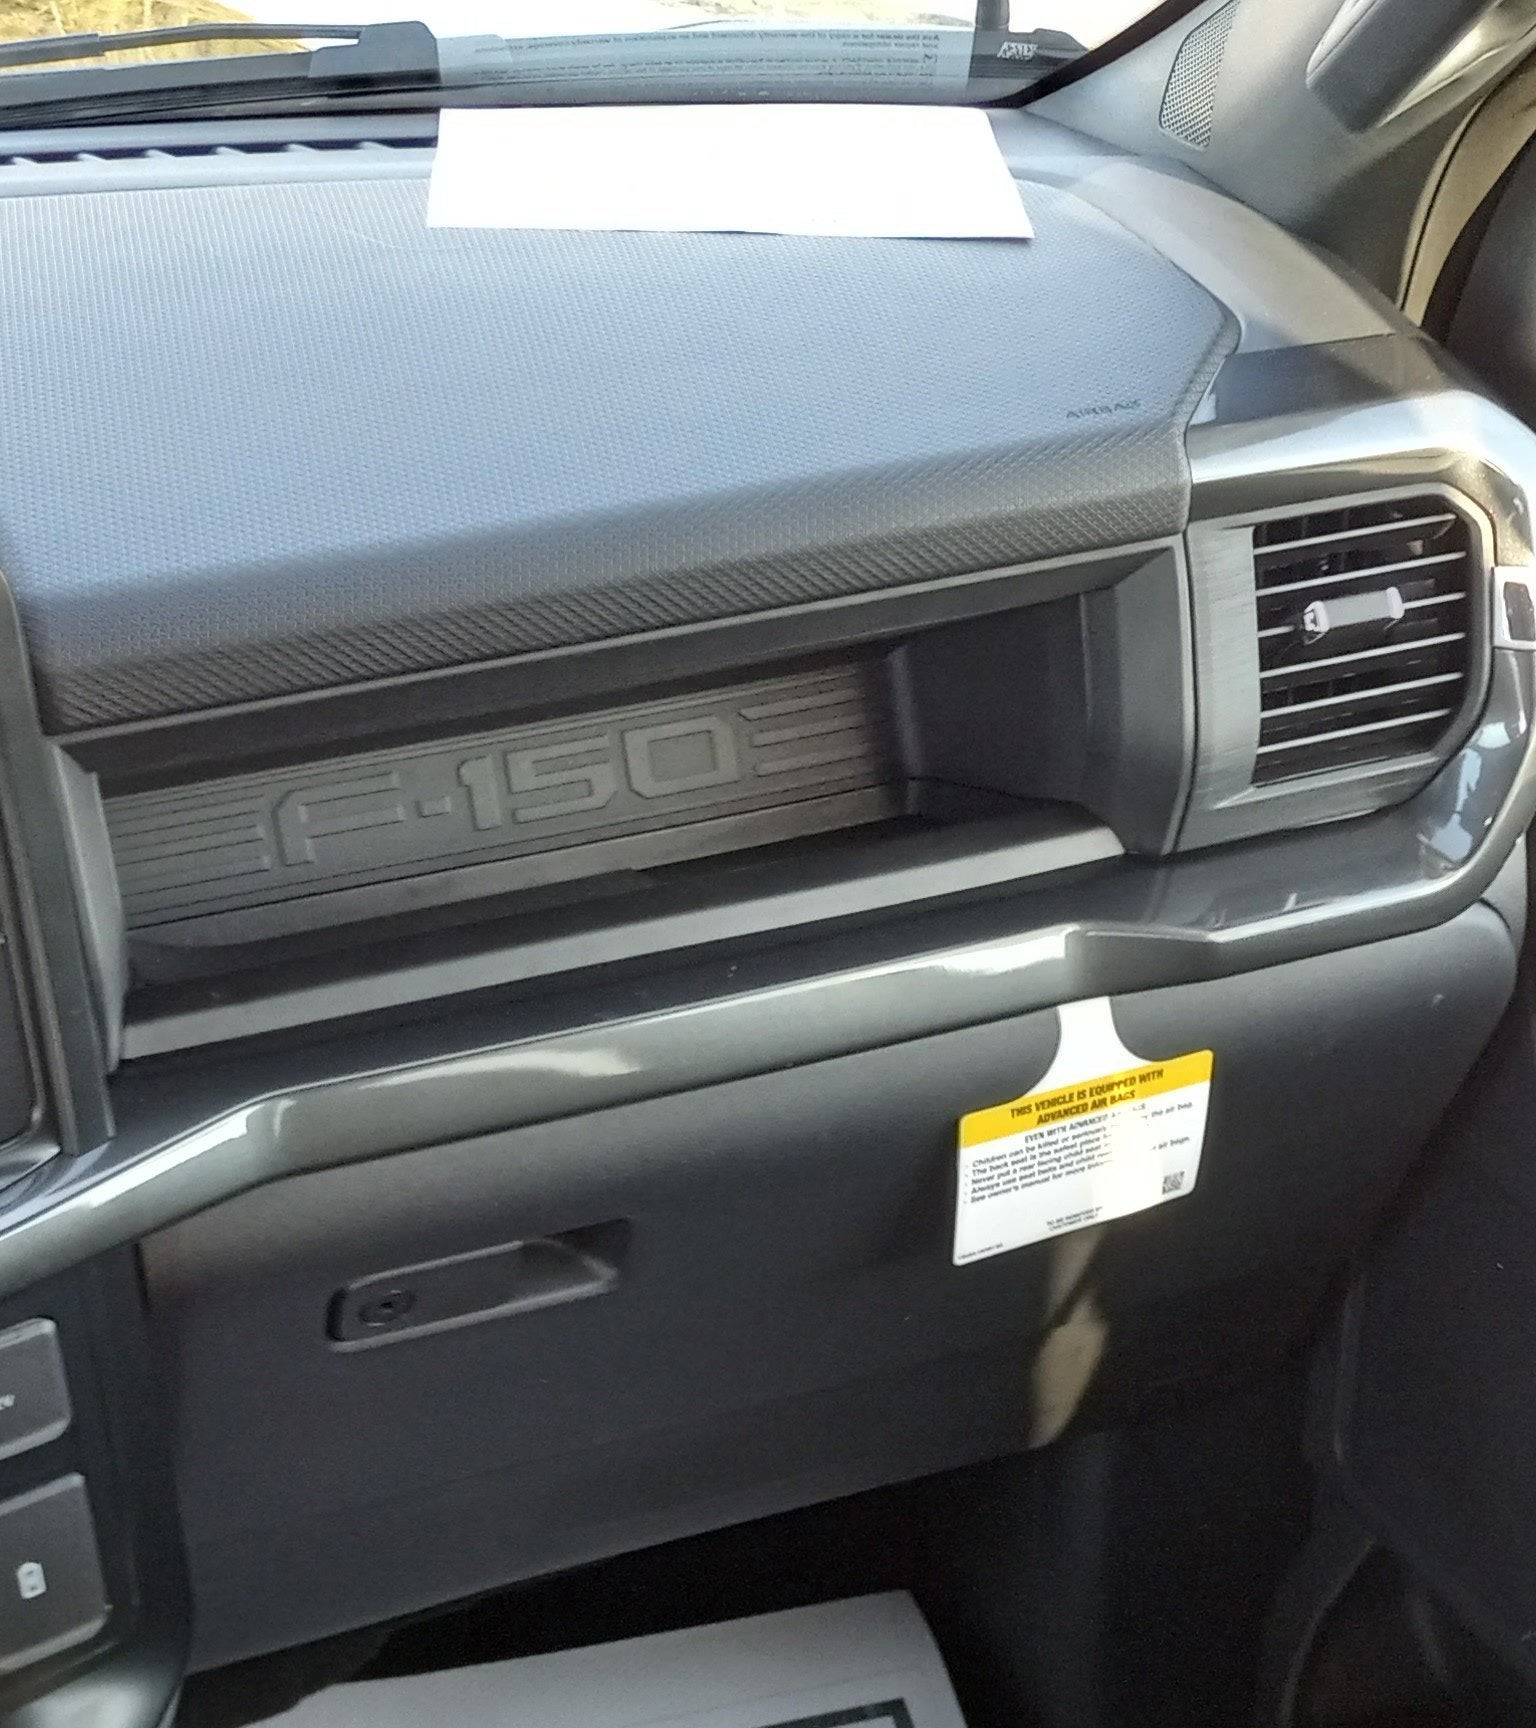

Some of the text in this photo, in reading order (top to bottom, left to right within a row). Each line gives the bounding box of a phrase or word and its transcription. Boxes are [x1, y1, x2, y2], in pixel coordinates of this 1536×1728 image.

[272, 716, 741, 868] F-150
[1011, 1104, 1032, 1119] THIS
[1035, 1091, 1074, 1111] VEHICLE
[1089, 1077, 1136, 1098] EQUIPPED
[1139, 1068, 1164, 1084] WITH
[1037, 1102, 1089, 1125] ADVANCED
[1090, 1098, 1108, 1111] AIR
